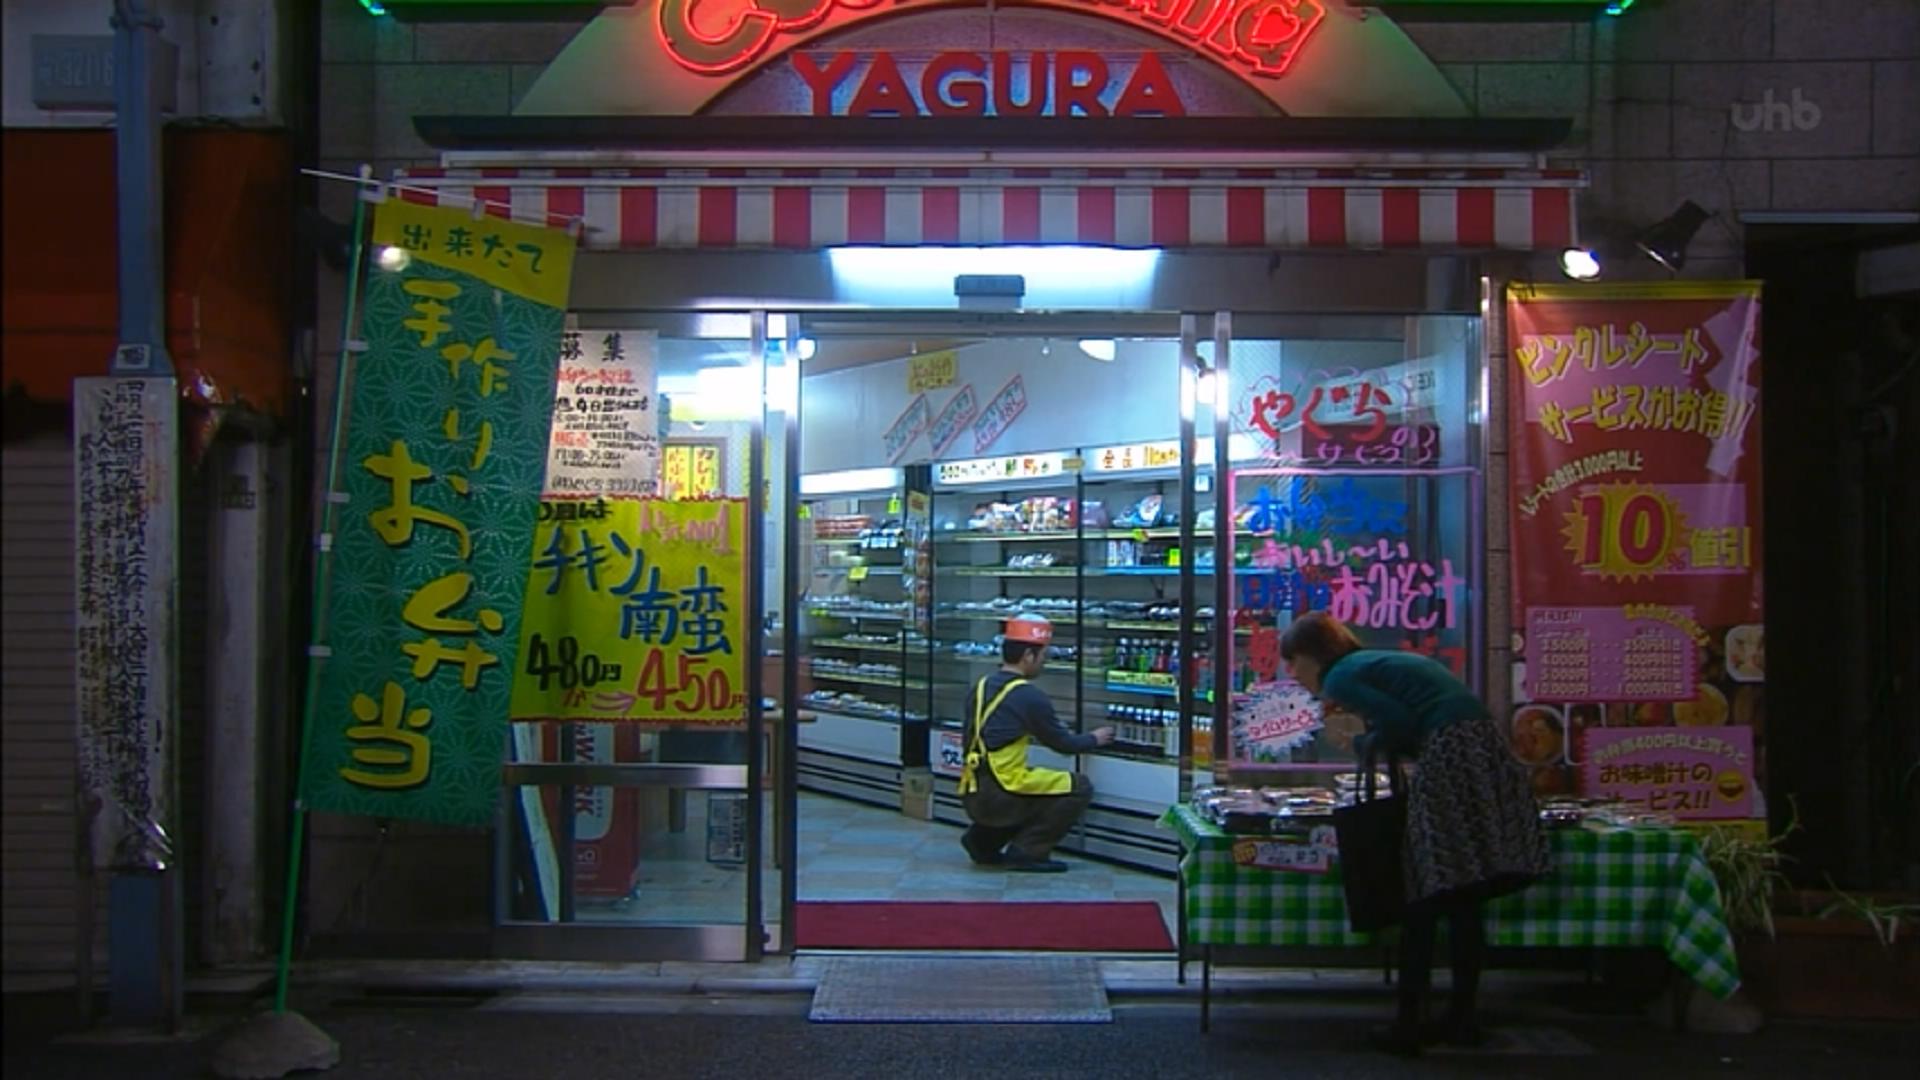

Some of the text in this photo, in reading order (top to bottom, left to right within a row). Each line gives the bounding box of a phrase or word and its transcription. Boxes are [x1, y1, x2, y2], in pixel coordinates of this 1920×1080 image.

[791, 50, 1186, 118] YAGURA
[400, 223, 544, 274] 出来たて
[533, 526, 644, 595] チキン
[619, 566, 732, 656] 南蛮
[525, 633, 622, 691] 480円
[636, 647, 745, 712] 450円
